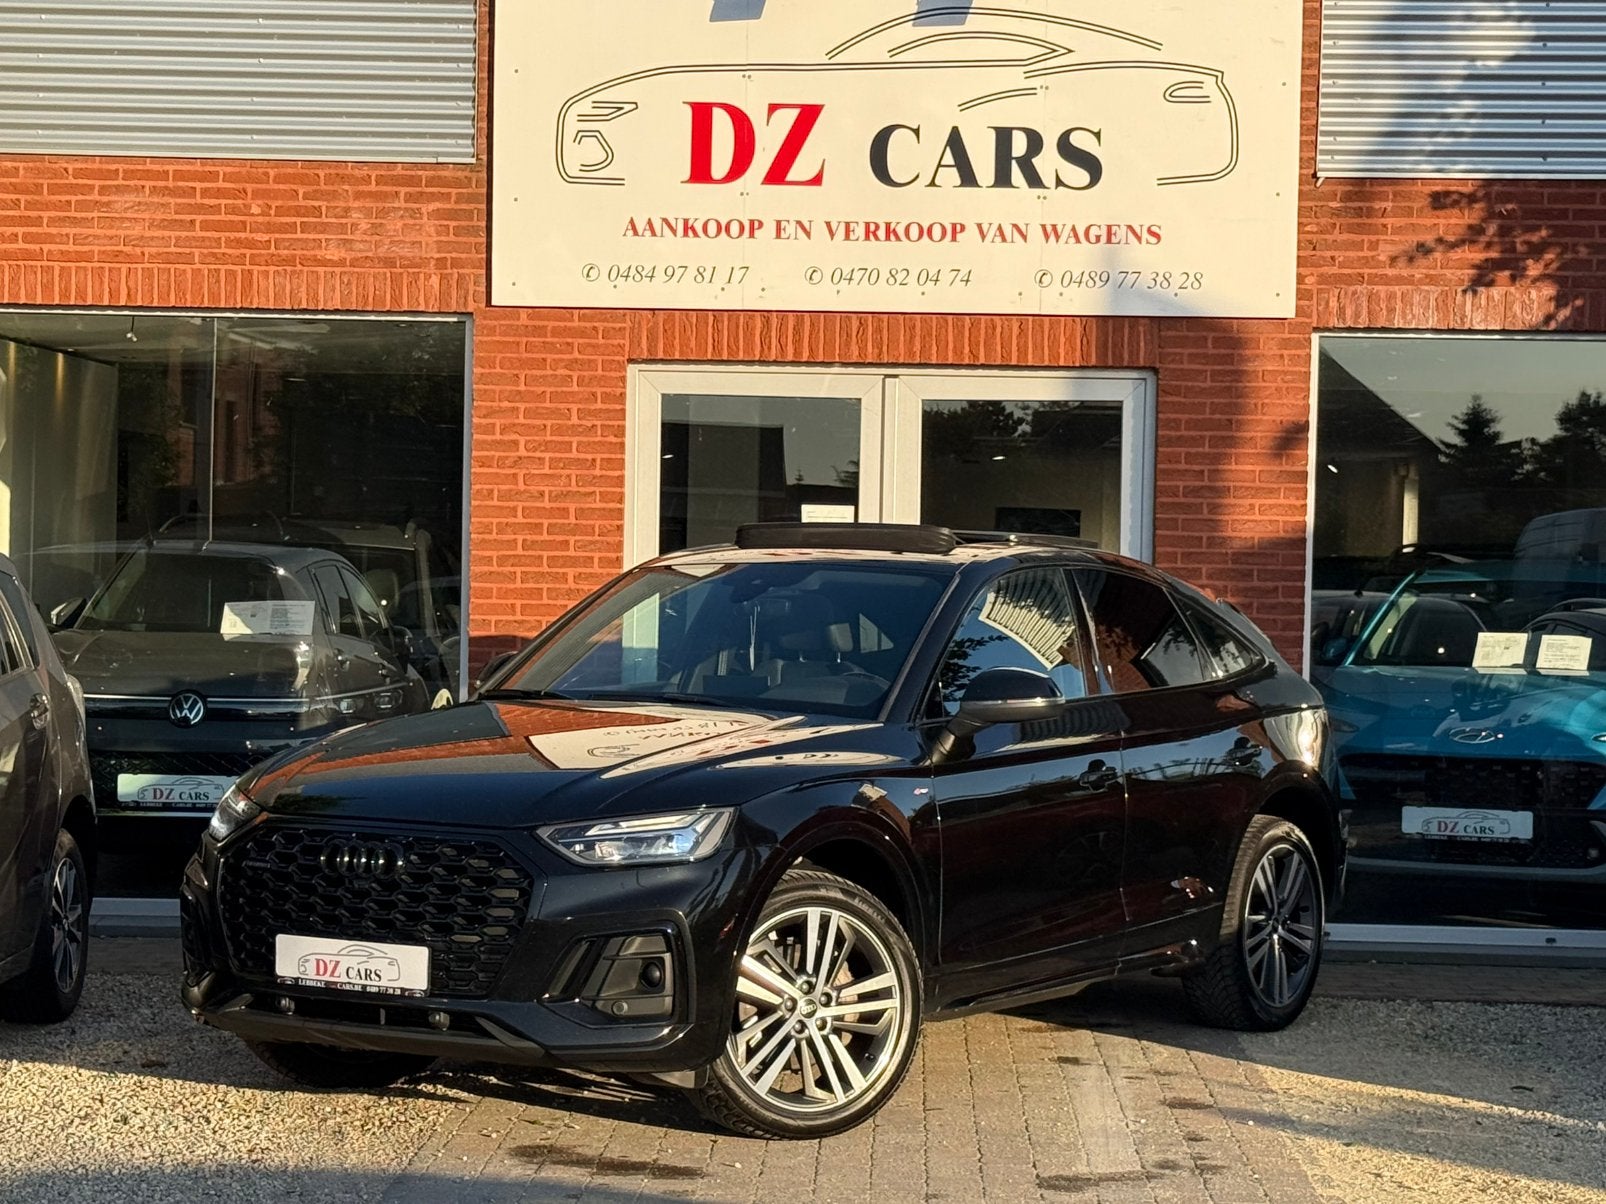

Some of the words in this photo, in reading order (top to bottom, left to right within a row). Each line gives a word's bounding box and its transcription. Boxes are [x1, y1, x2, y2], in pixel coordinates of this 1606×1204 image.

[680, 101, 826, 187] DZ
[869, 123, 1103, 191] CARS
[622, 216, 765, 240] AANKOOP
[773, 219, 814, 241] EN
[823, 220, 967, 243] VERKOOP
[974, 222, 1029, 244] VAN
[1039, 223, 1162, 246] WAGENS
[607, 264, 657, 283] 0484
[663, 265, 688, 284] 97
[693, 265, 717, 284] 81
[725, 266, 750, 285] 17
[830, 267, 880, 286] 0470
[885, 268, 910, 287] 82
[916, 268, 942, 287] 04
[948, 269, 973, 287] 74
[1060, 270, 1111, 289] 0489
[1117, 271, 1142, 289] 77
[1147, 271, 1173, 290] 38
[1178, 271, 1204, 290] 28
[152, 787, 175, 801] DZ
[179, 791, 210, 801] CARS
[1437, 820, 1459, 834] DZ
[1463, 824, 1495, 835] CARS
[314, 958, 341, 978] DZ
[346, 966, 382, 982] CARS
